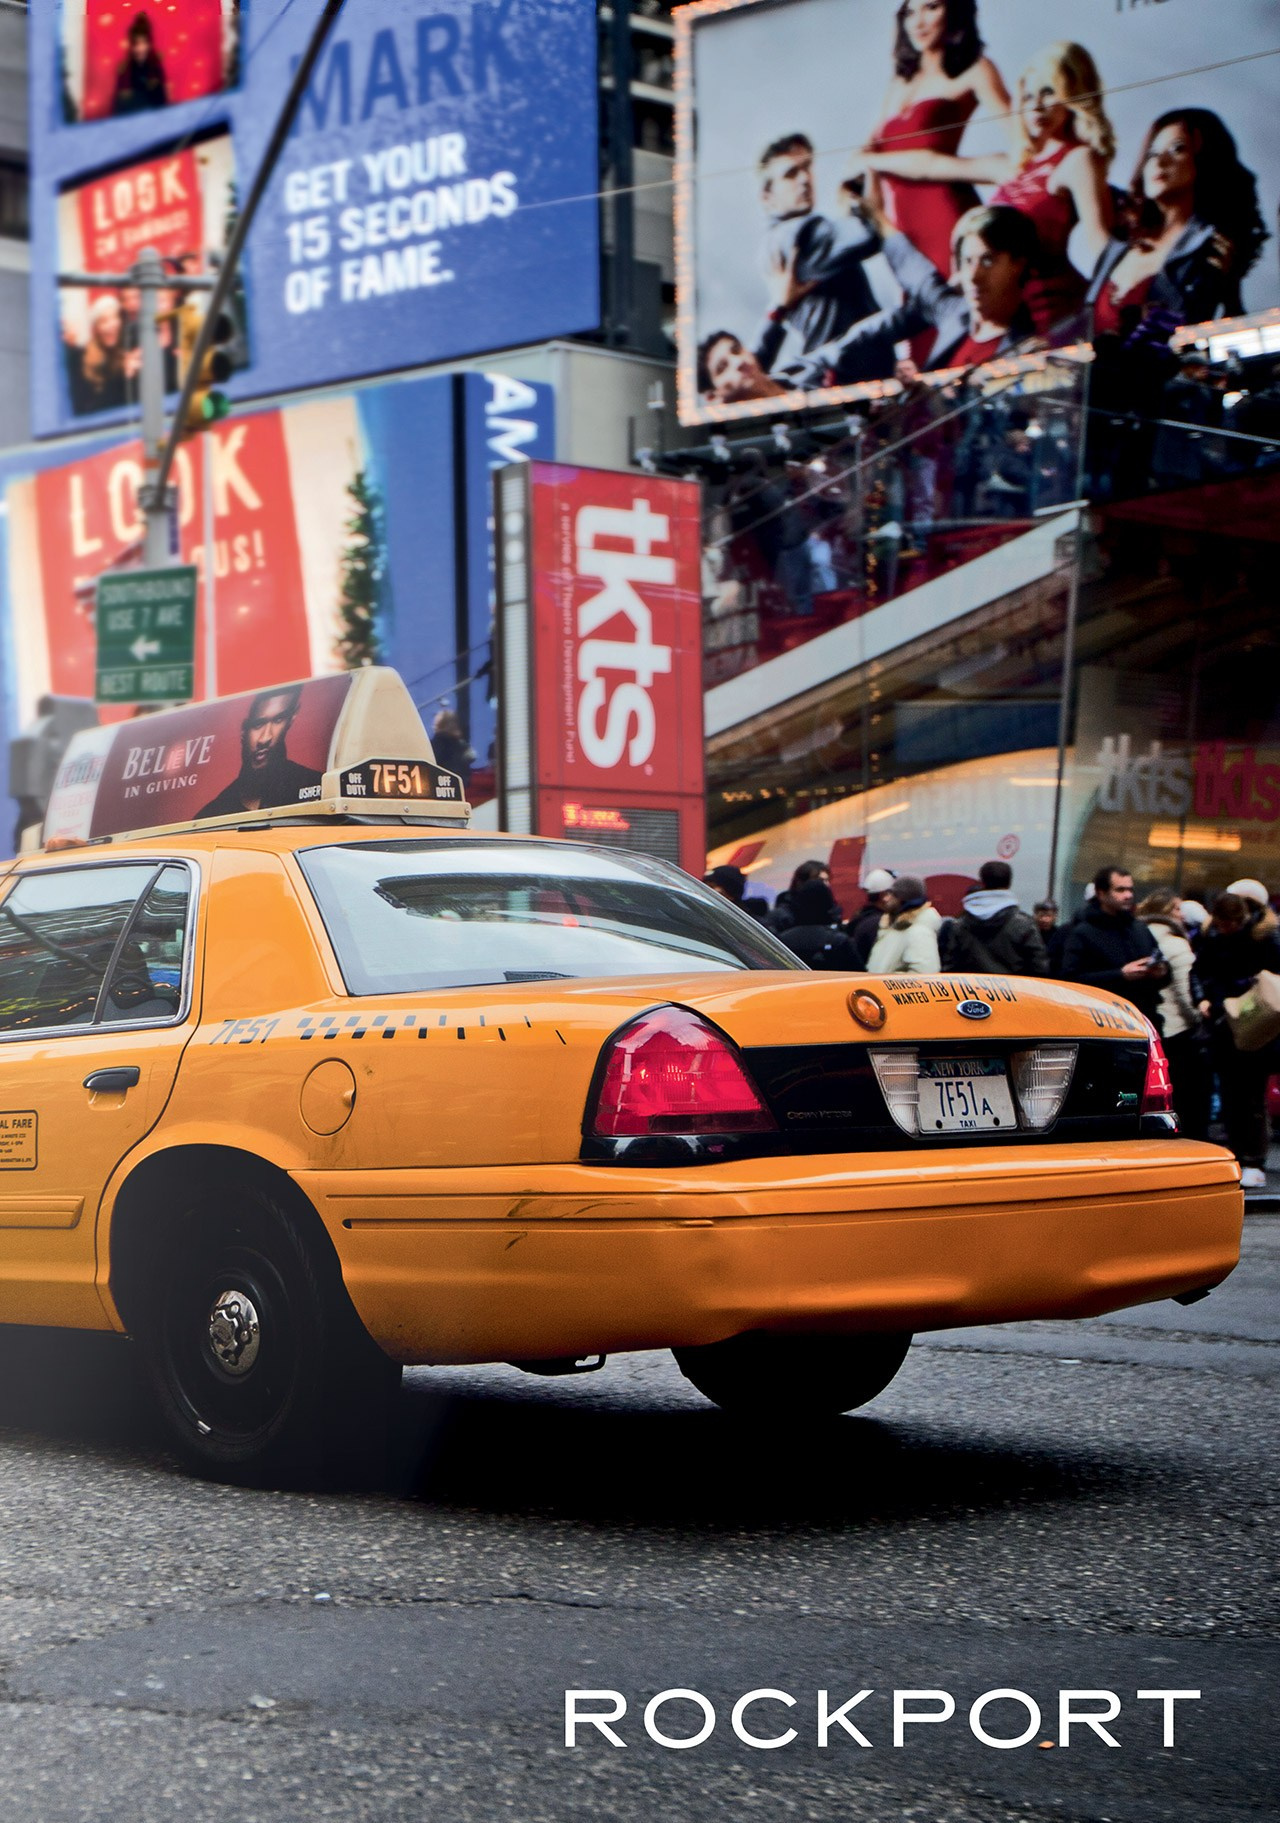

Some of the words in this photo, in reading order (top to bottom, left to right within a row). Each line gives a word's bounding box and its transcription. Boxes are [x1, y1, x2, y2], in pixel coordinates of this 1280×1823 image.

[290, 2, 518, 139] MARK
[284, 158, 353, 214] GET
[362, 131, 468, 195] YOUR
[285, 216, 331, 264] 15
[338, 170, 519, 252] SECONDS
[284, 266, 331, 315] OF
[340, 240, 456, 302] FAME.
[575, 498, 676, 769] tkts
[121, 734, 216, 780] BELIEVE
[124, 786, 141, 799] IN
[146, 773, 199, 794] GIVING
[298, 785, 321, 800] USHER
[346, 784, 367, 796] DUTY
[435, 786, 455, 798] DUTY
[348, 772, 363, 784] OFF
[369, 763, 424, 795] 7F51
[437, 775, 452, 787] OFF
[882, 979, 923, 992] DRIVERS
[924, 981, 950, 998] 718
[891, 991, 930, 1006] WANTED
[209, 1018, 281, 1046] 7F51
[934, 1062, 957, 1078] NEW
[957, 1061, 985, 1076] YORK
[11, 1118, 33, 1129] FARE
[959, 1120, 977, 1128] TAXI
